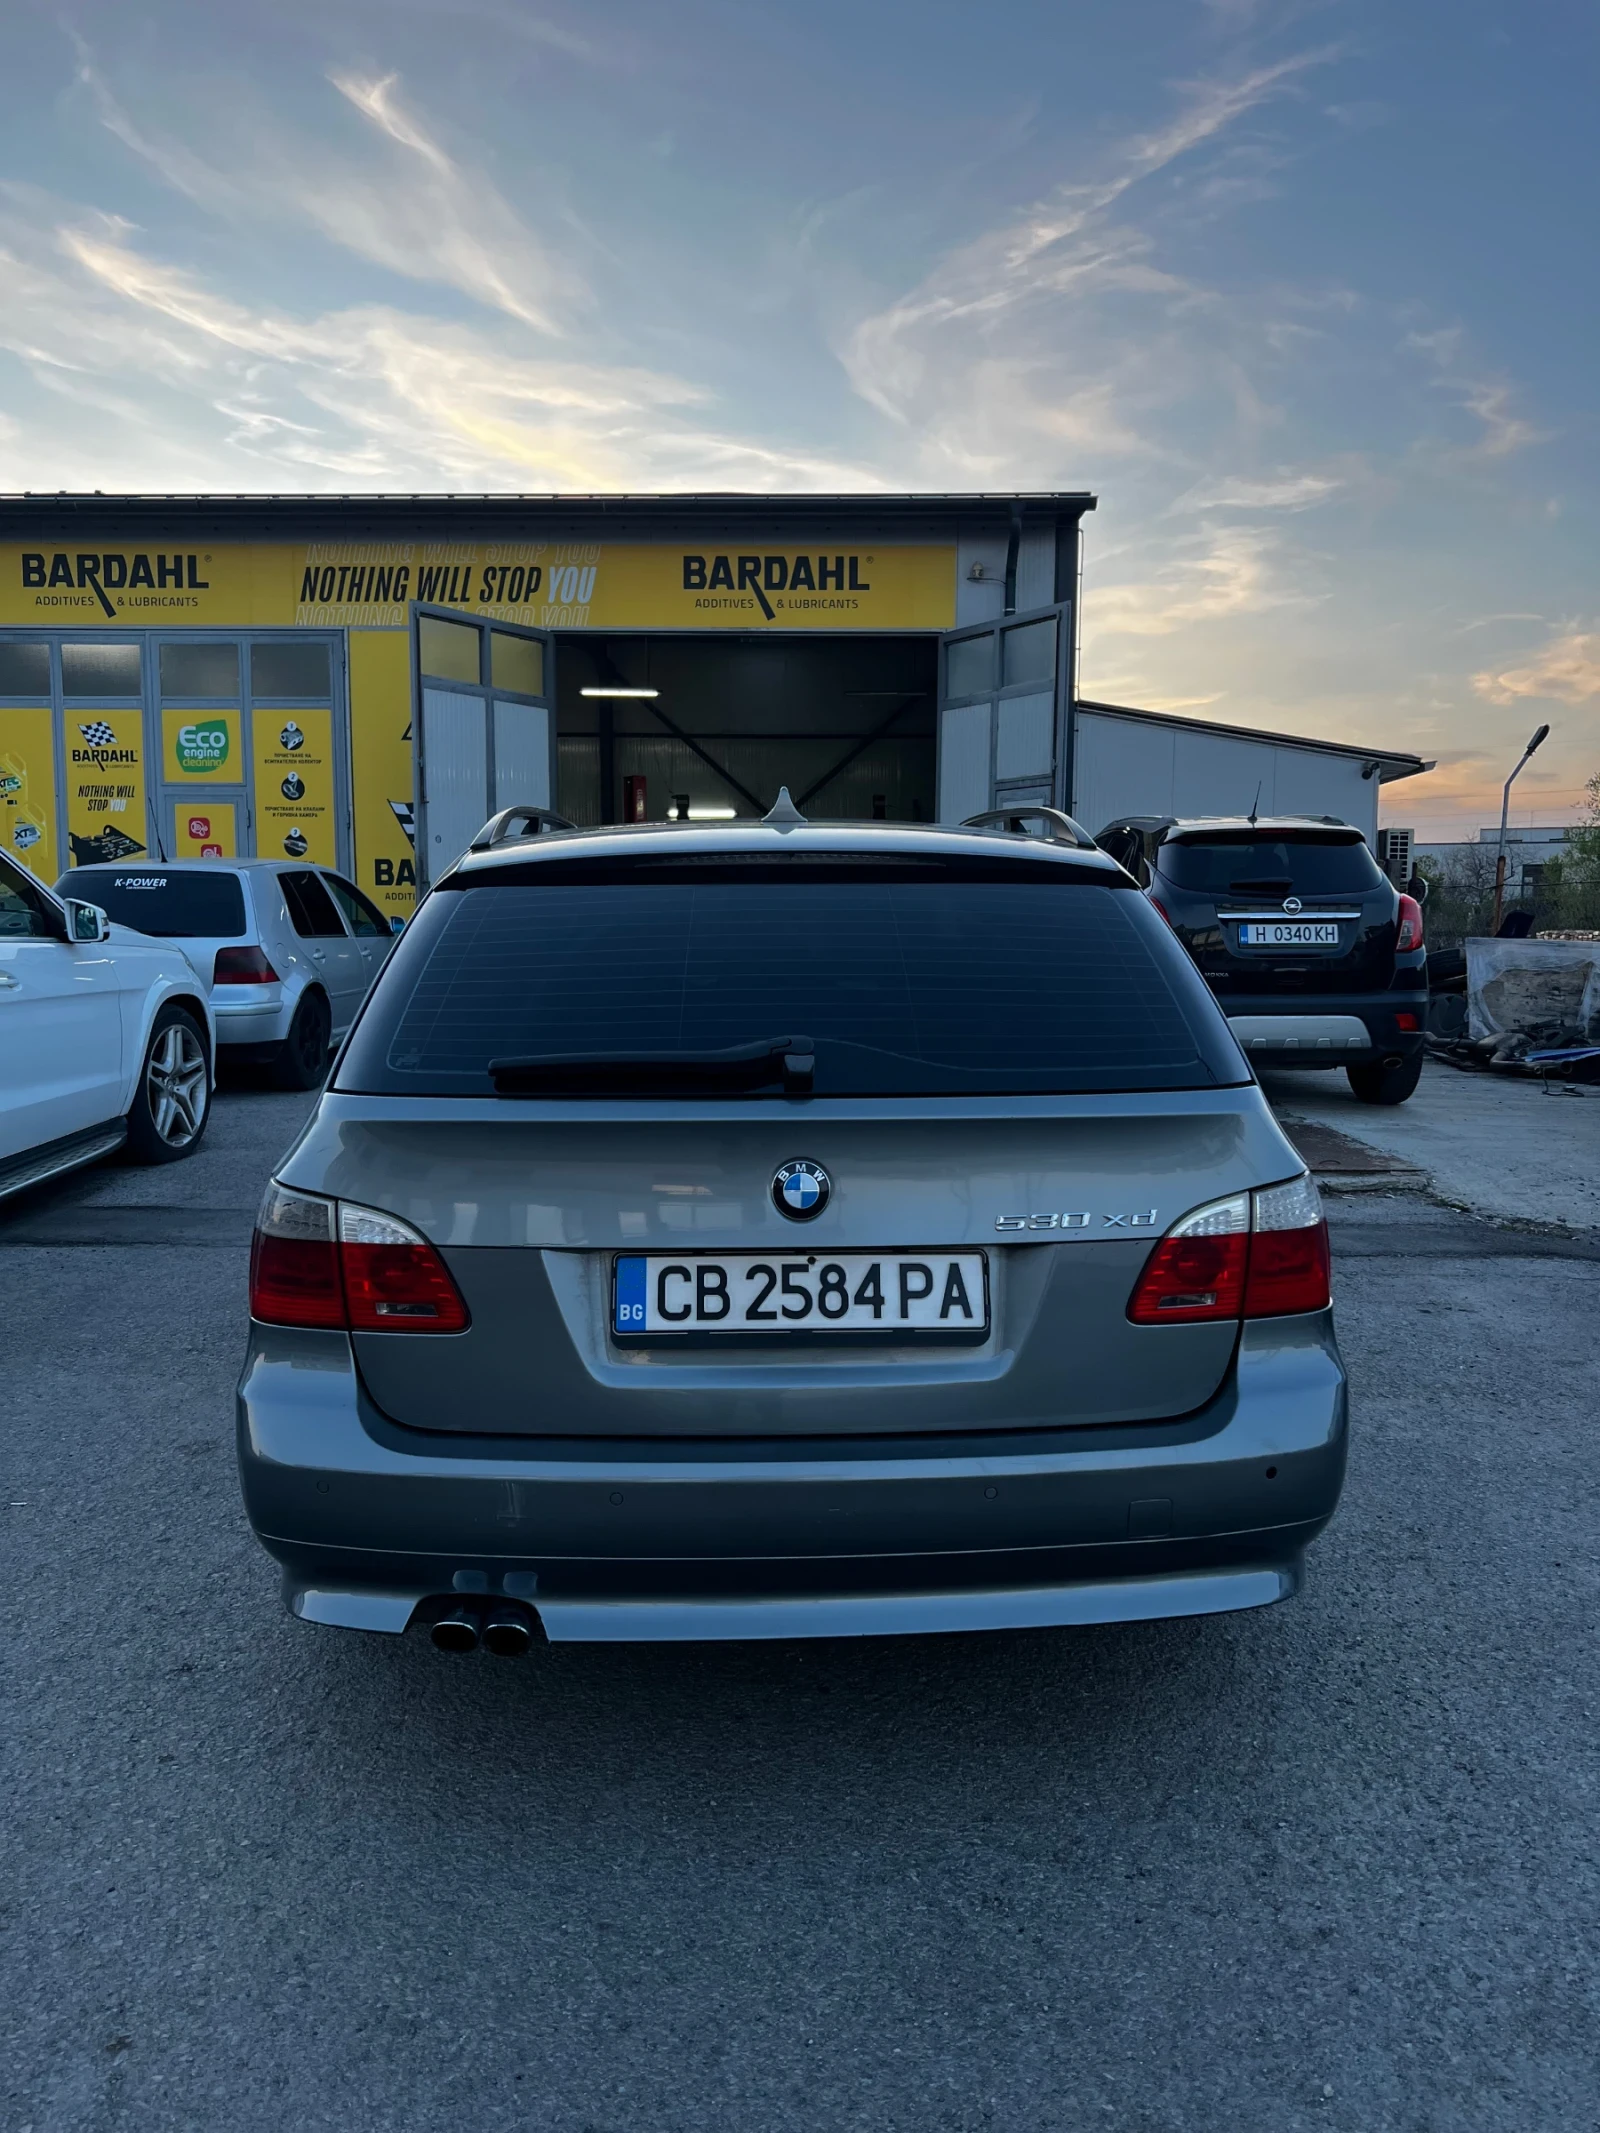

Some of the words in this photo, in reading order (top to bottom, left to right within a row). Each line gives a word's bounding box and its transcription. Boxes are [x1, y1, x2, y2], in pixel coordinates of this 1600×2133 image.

[22, 553, 209, 618] BARDAHL
[300, 566, 410, 603] NOTHING
[416, 566, 472, 603] WILL
[479, 566, 542, 603] STOP
[547, 566, 597, 604] YOU
[683, 555, 870, 621] BARDAHL
[35, 596, 95, 607] ADDITIVES
[116, 597, 125, 607] &
[128, 597, 199, 608] LUBRICANTS
[695, 598, 754, 609] ADDITIVES
[776, 599, 785, 609] &
[788, 599, 859, 610] LUBRICANTS
[179, 725, 226, 748] Eco
[72, 749, 138, 772] BARDAHL
[183, 748, 221, 760] engine
[182, 757, 222, 769] cleaning
[78, 785, 115, 798] NOTHING
[116, 785, 136, 798] WILL
[87, 799, 109, 812] STOP
[110, 799, 127, 812] YOU
[114, 878, 168, 887] K-POWER
[385, 892, 415, 901] ADDITI
[1255, 926, 1266, 942] H
[1274, 926, 1312, 942] 0340
[1315, 926, 1336, 942] KH
[778, 1163, 825, 1182] BMW
[994, 1211, 1092, 1232] 530
[1102, 1208, 1158, 1228] xd
[657, 1264, 731, 1322] CB
[745, 1263, 886, 1321] 2584
[899, 1262, 974, 1319] PA
[619, 1303, 644, 1321] BG
